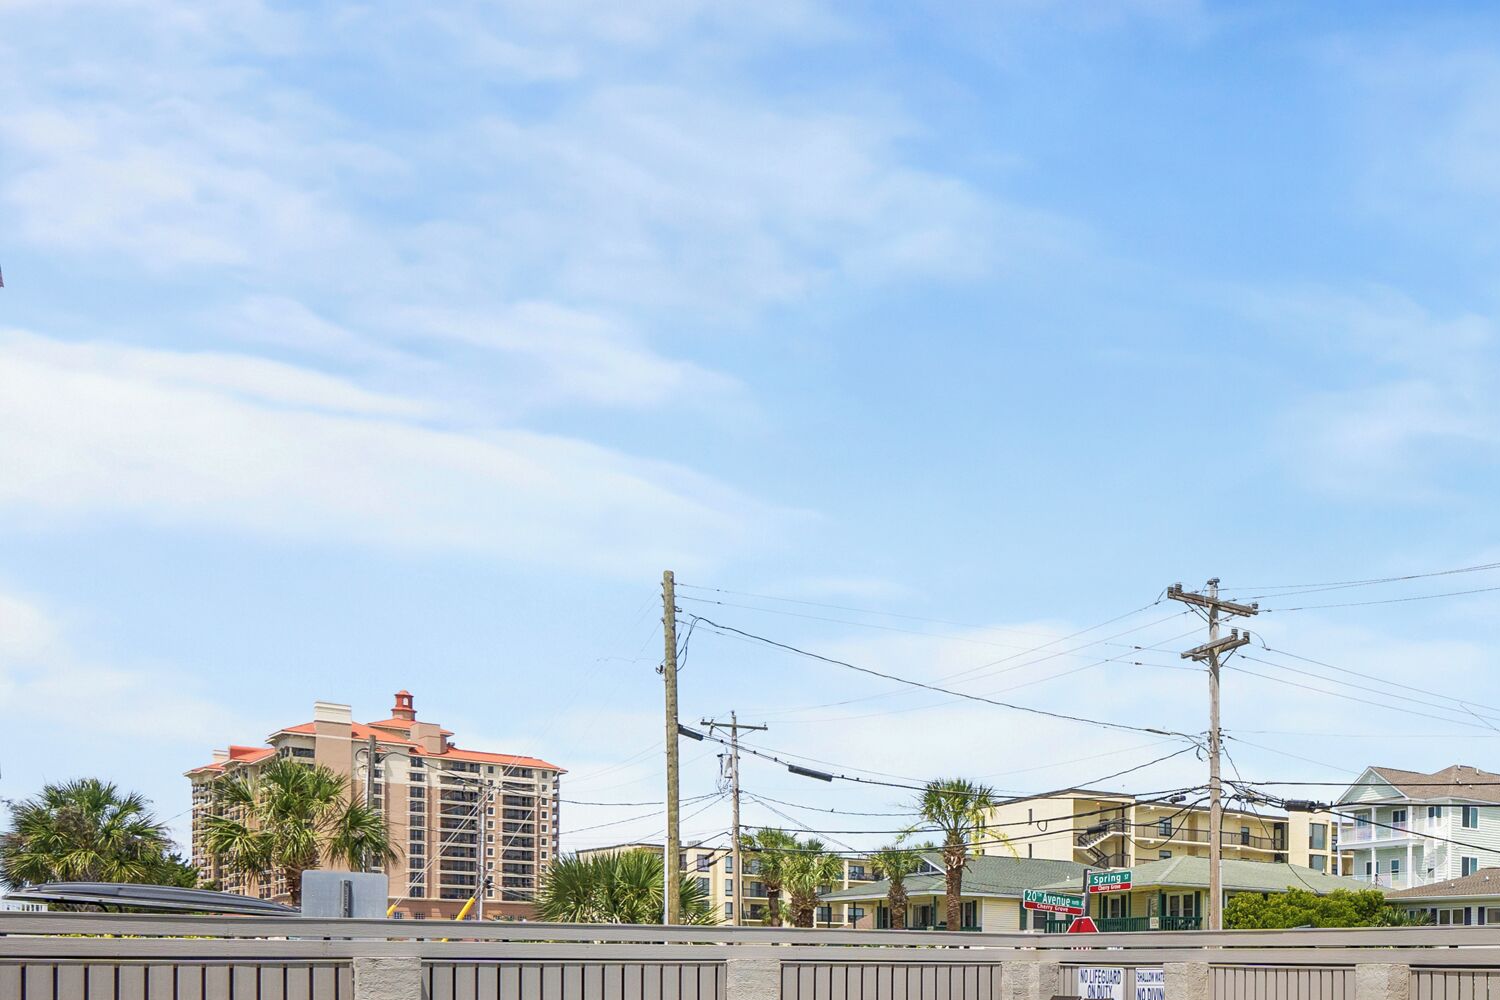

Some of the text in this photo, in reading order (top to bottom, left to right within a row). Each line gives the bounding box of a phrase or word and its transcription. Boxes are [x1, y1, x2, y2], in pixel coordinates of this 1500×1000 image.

[1094, 873, 1121, 886] Spring
[1042, 893, 1071, 907] Avenue
[1036, 903, 1053, 911] Cherry
[1080, 969, 1121, 985] NO LIFEGUARD
[1137, 971, 1154, 982] SHALLOW
[1088, 984, 1113, 999] ON DUTY
